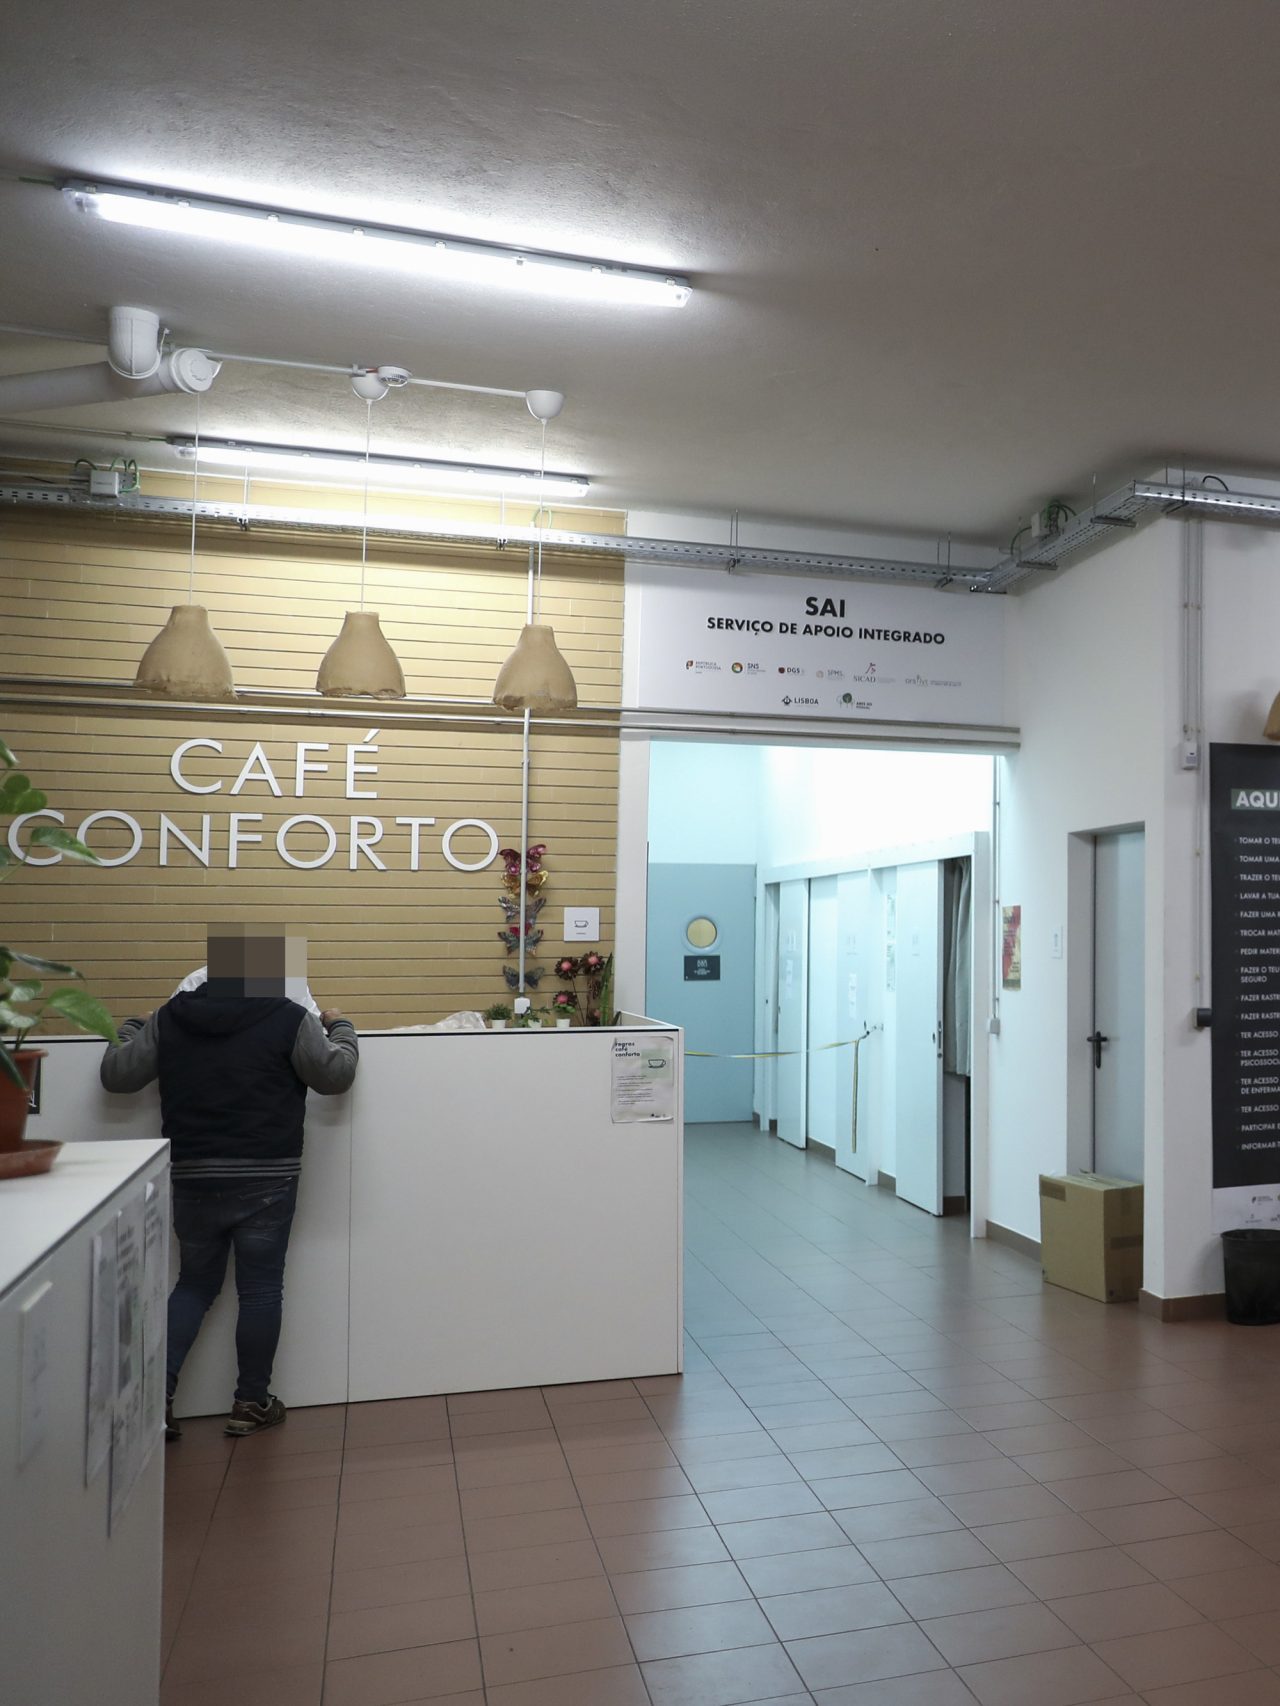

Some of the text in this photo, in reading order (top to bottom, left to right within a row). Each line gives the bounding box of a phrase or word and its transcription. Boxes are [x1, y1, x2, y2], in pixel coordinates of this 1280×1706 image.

[805, 596, 845, 618] SAI
[707, 617, 945, 645] SERVIÇO DE APOIO INTEGRADO
[747, 662, 760, 670] SNS
[794, 697, 819, 705] LISBOA
[169, 728, 380, 799] CAFÉ
[7, 808, 499, 872] CONFORTO
[1239, 837, 1262, 845] TOMAR
[1264, 837, 1271, 845] O
[1239, 855, 1263, 863] TOMAR
[1240, 892, 1260, 900] LAVAR
[1261, 892, 1267, 900] A
[1268, 892, 1280, 900] TUA
[1240, 947, 1258, 955] PEDIR
[1240, 966, 1259, 974] FAZER
[1240, 975, 1268, 983] SEGURO
[1240, 994, 1260, 1002] FAZER
[1240, 1012, 1260, 1020] FAZER
[1240, 1031, 1252, 1039] TER
[1253, 1030, 1279, 1038] ACESSO
[1253, 1076, 1279, 1084] ACESSO
[1240, 1087, 1249, 1095] DE
[1253, 1104, 1279, 1112] ACESSO
[1241, 1123, 1275, 1132] PARTICIPAR
